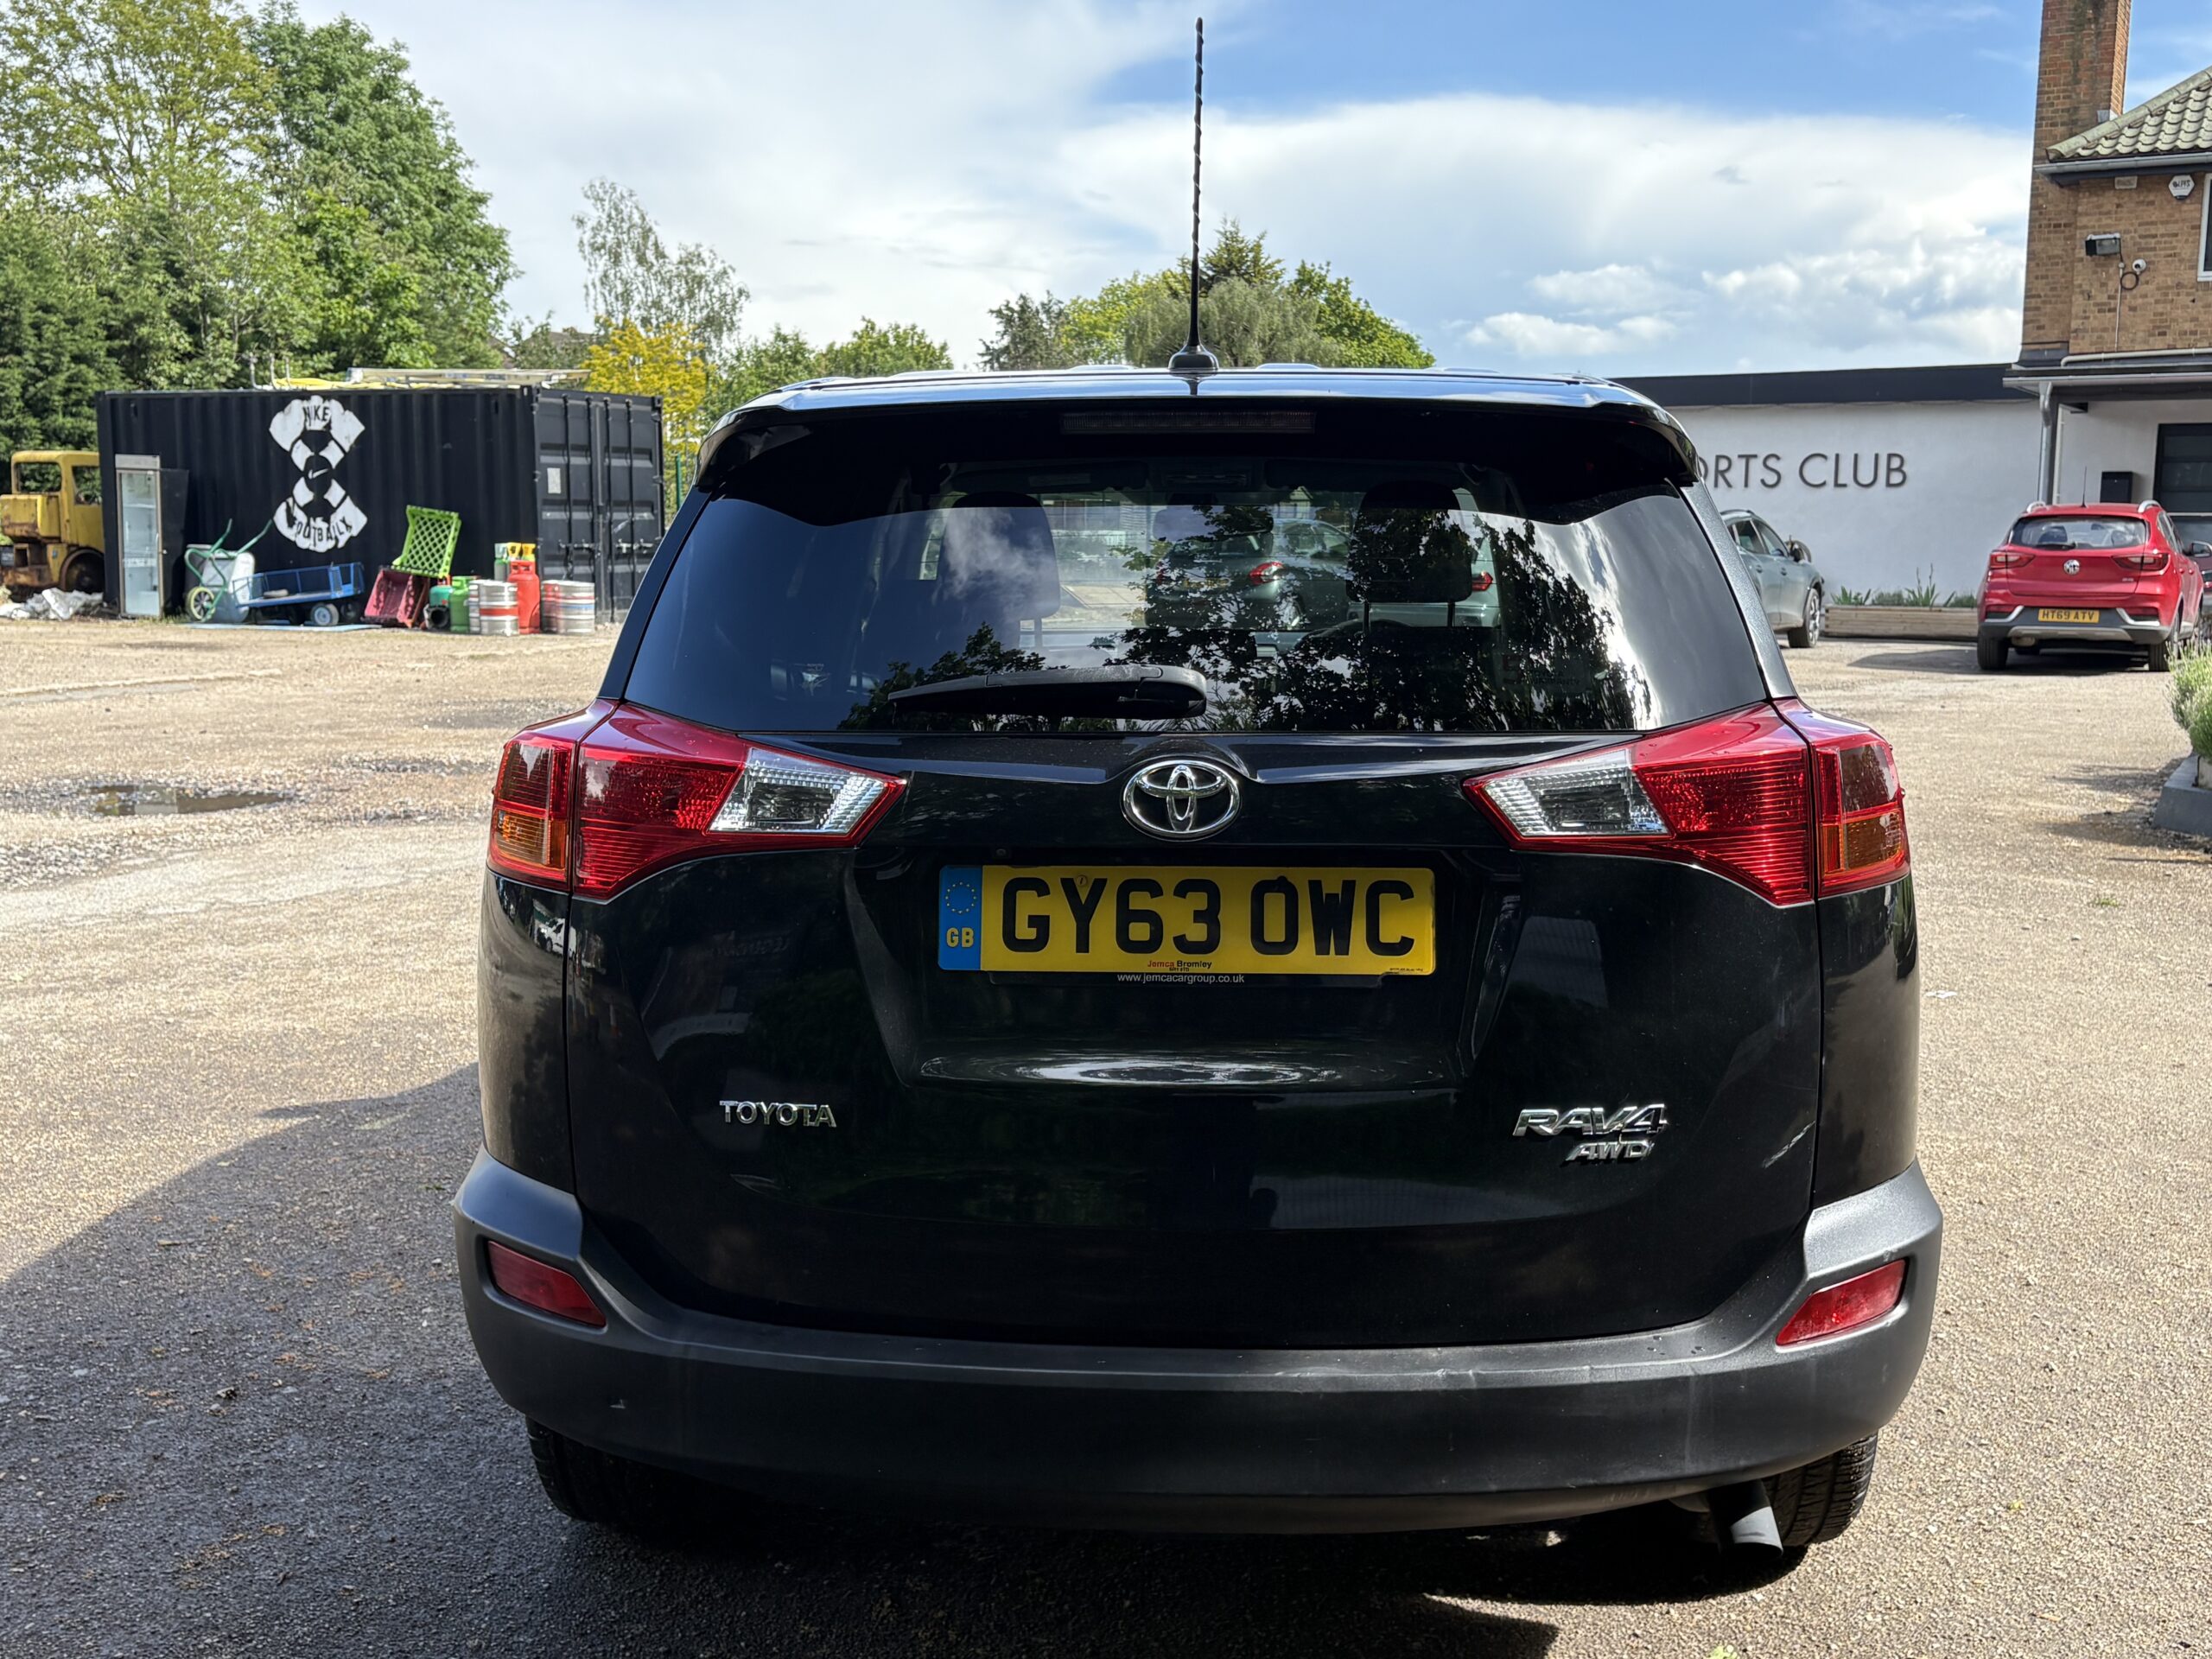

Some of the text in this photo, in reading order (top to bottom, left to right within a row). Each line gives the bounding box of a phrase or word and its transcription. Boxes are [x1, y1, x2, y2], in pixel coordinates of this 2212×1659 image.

[1798, 452, 1908, 488] CLUB
[2041, 609, 2095, 621] HT69 ATV
[1001, 876, 1415, 957] GY63 OWC
[946, 927, 975, 948] GB
[1176, 960, 1212, 969] Bromley
[1117, 973, 1245, 984] www.jemcacargroup.co.uk
[719, 1100, 837, 1128] TOYOTA
[1512, 1103, 1669, 1136] RAV4
[1565, 1140, 1653, 1161] AWD
